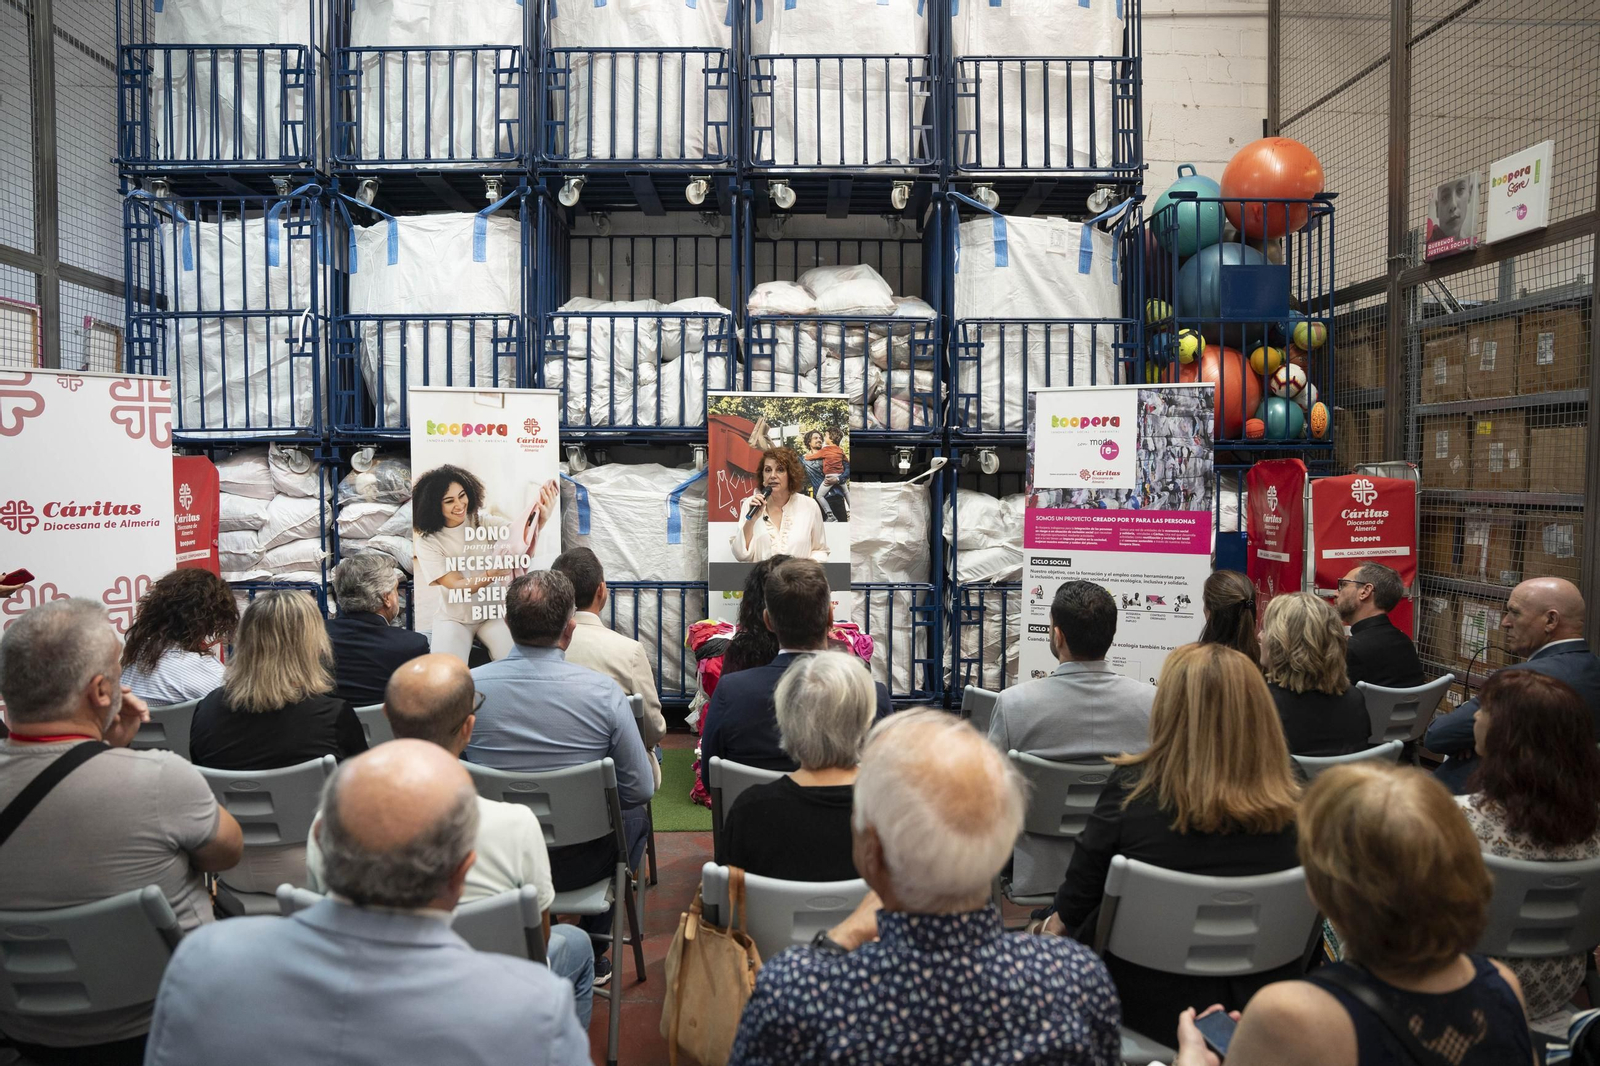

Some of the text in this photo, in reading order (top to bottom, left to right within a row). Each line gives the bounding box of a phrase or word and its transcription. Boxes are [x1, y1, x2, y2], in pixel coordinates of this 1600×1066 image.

[1507, 178, 1529, 197] Store
[1427, 239, 1469, 256] JUSTICIA SOCIAL
[1428, 238, 1454, 250] QUEREMOS
[426, 420, 508, 437] koopera
[1051, 415, 1120, 429] koopera
[42, 501, 142, 518] Cáritas
[1341, 508, 1389, 519] Cáritas
[43, 518, 160, 532] Diocesana de Almería
[174, 514, 200, 523] Cáritas
[464, 526, 510, 541] DONO
[463, 544, 497, 552] porque
[445, 554, 531, 571] NECESARIO
[474, 575, 510, 585] porque
[448, 586, 508, 603] ME SIEN
[471, 604, 507, 620] BIEN
